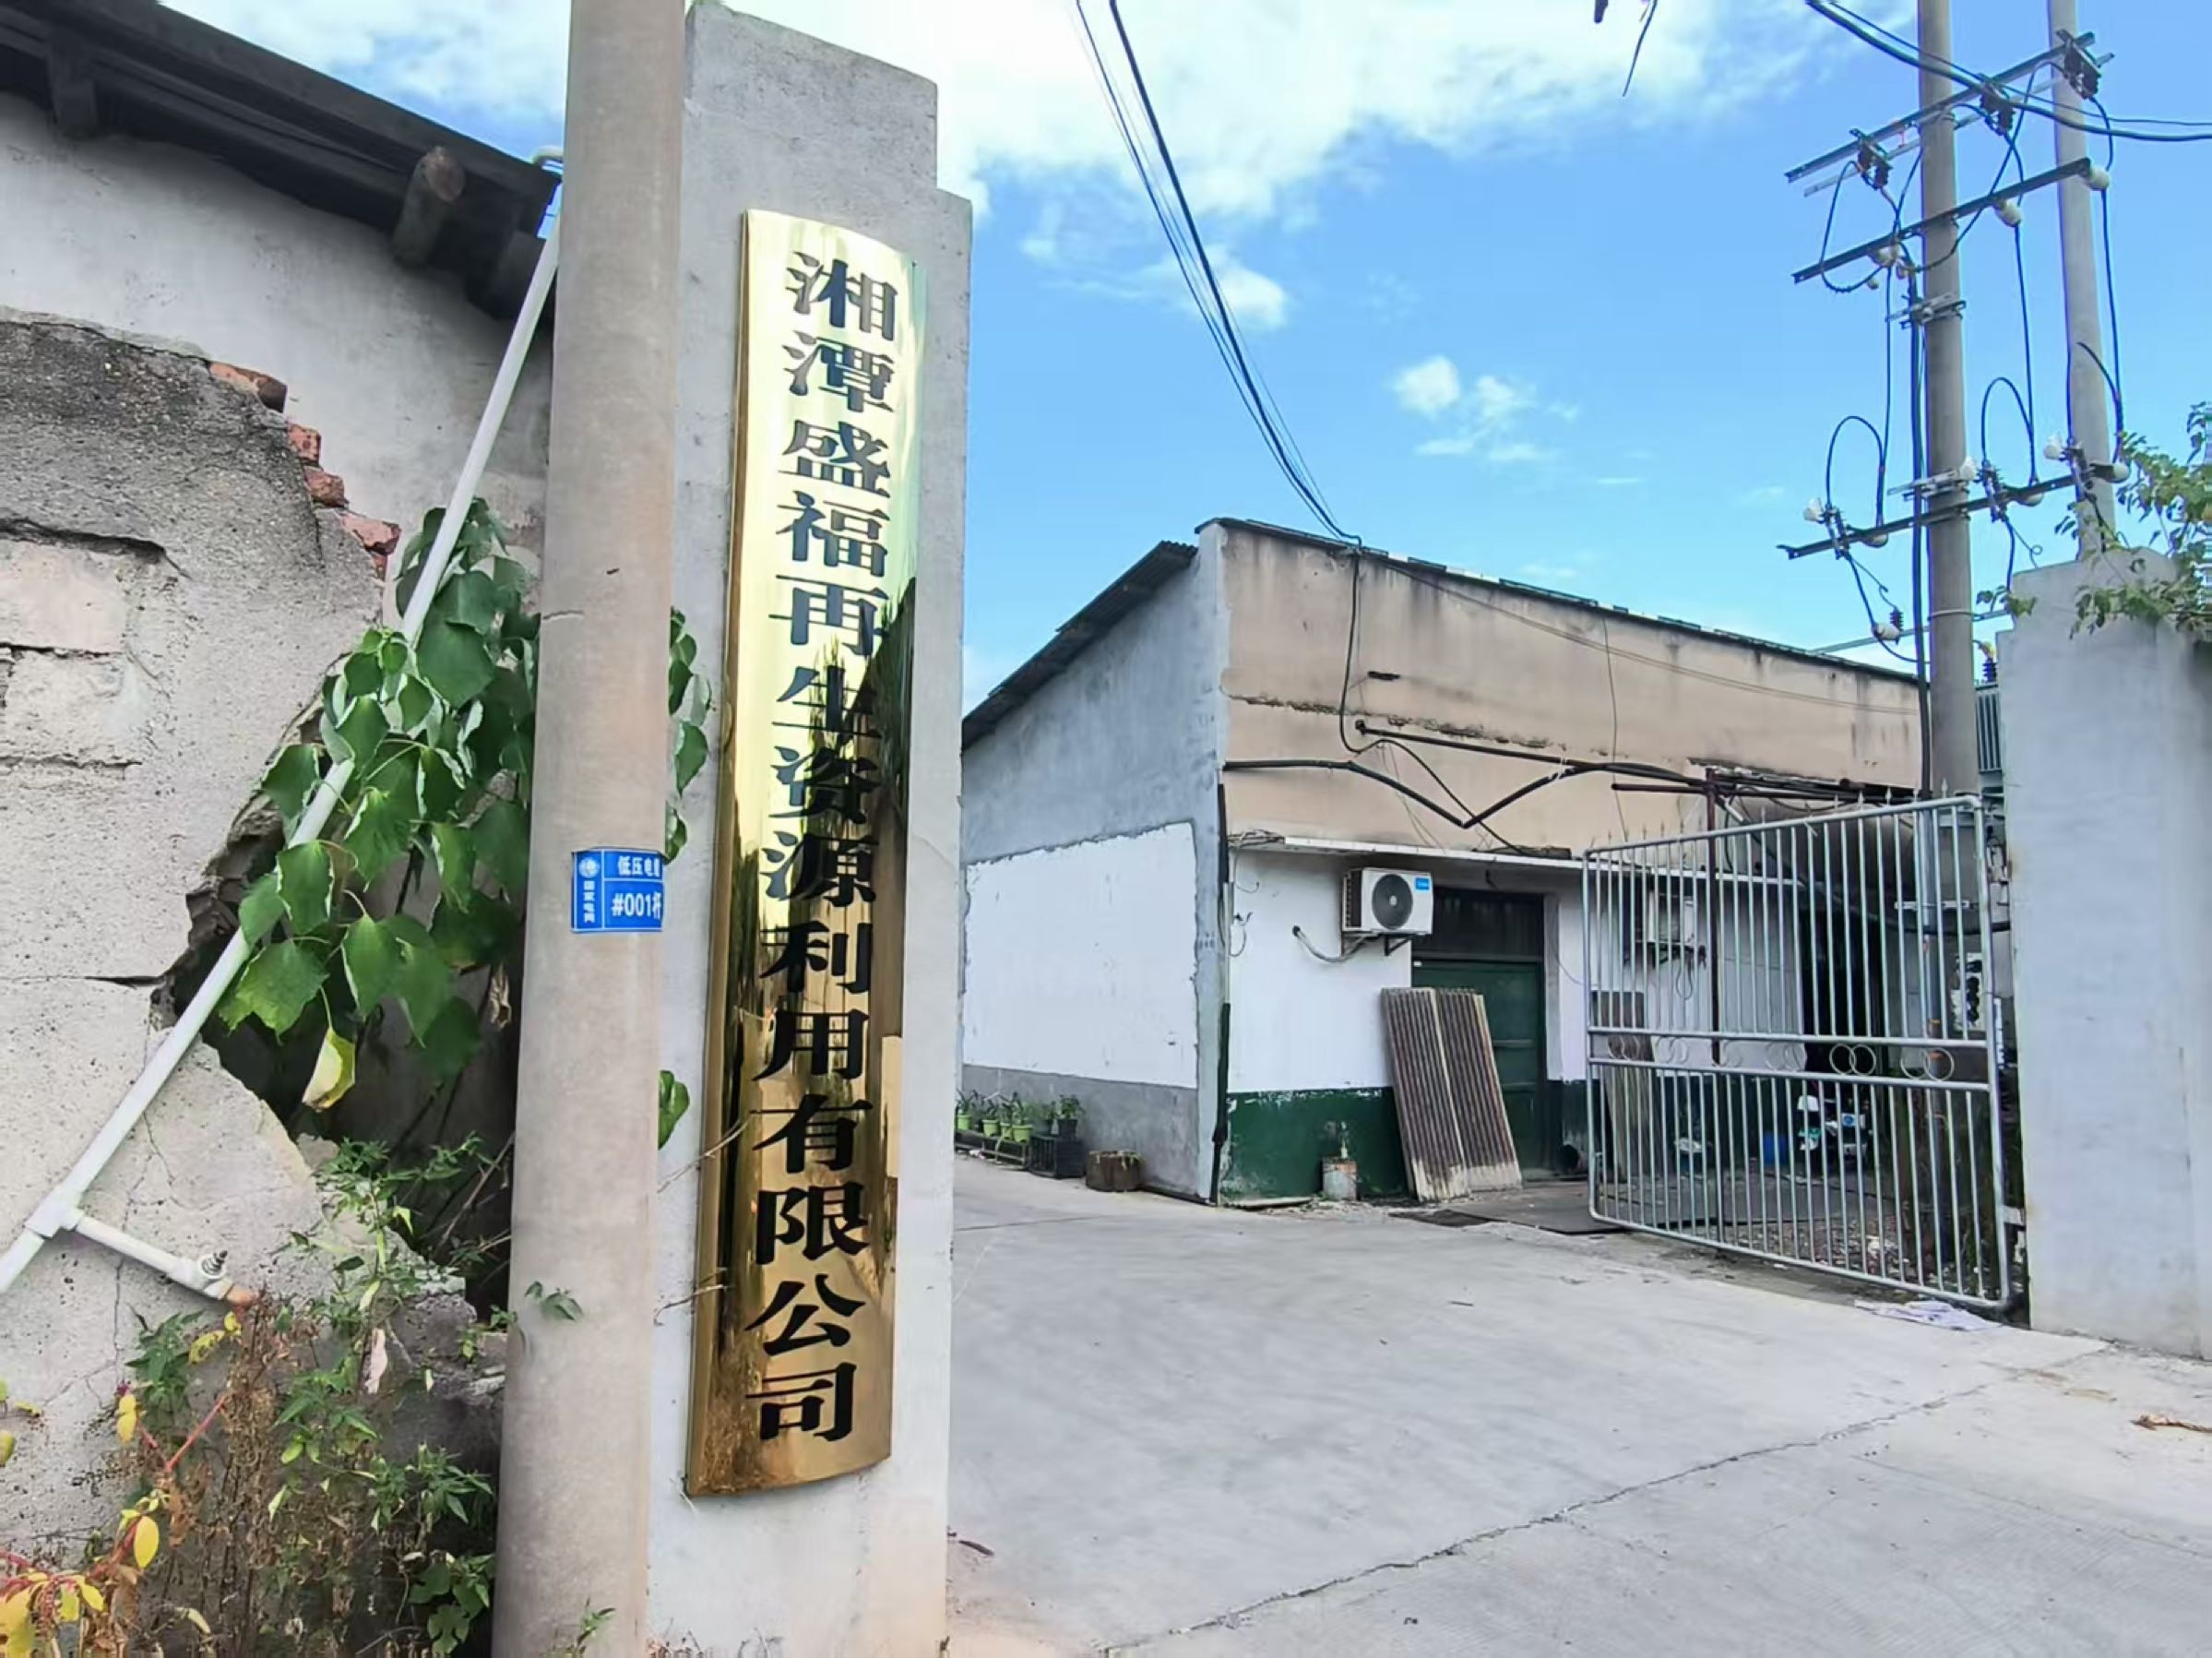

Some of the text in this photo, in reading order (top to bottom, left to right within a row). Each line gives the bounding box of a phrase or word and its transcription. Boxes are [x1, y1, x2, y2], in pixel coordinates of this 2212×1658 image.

[745, 250, 898, 1442] 湘潭盛福再生资源利用有限公司
